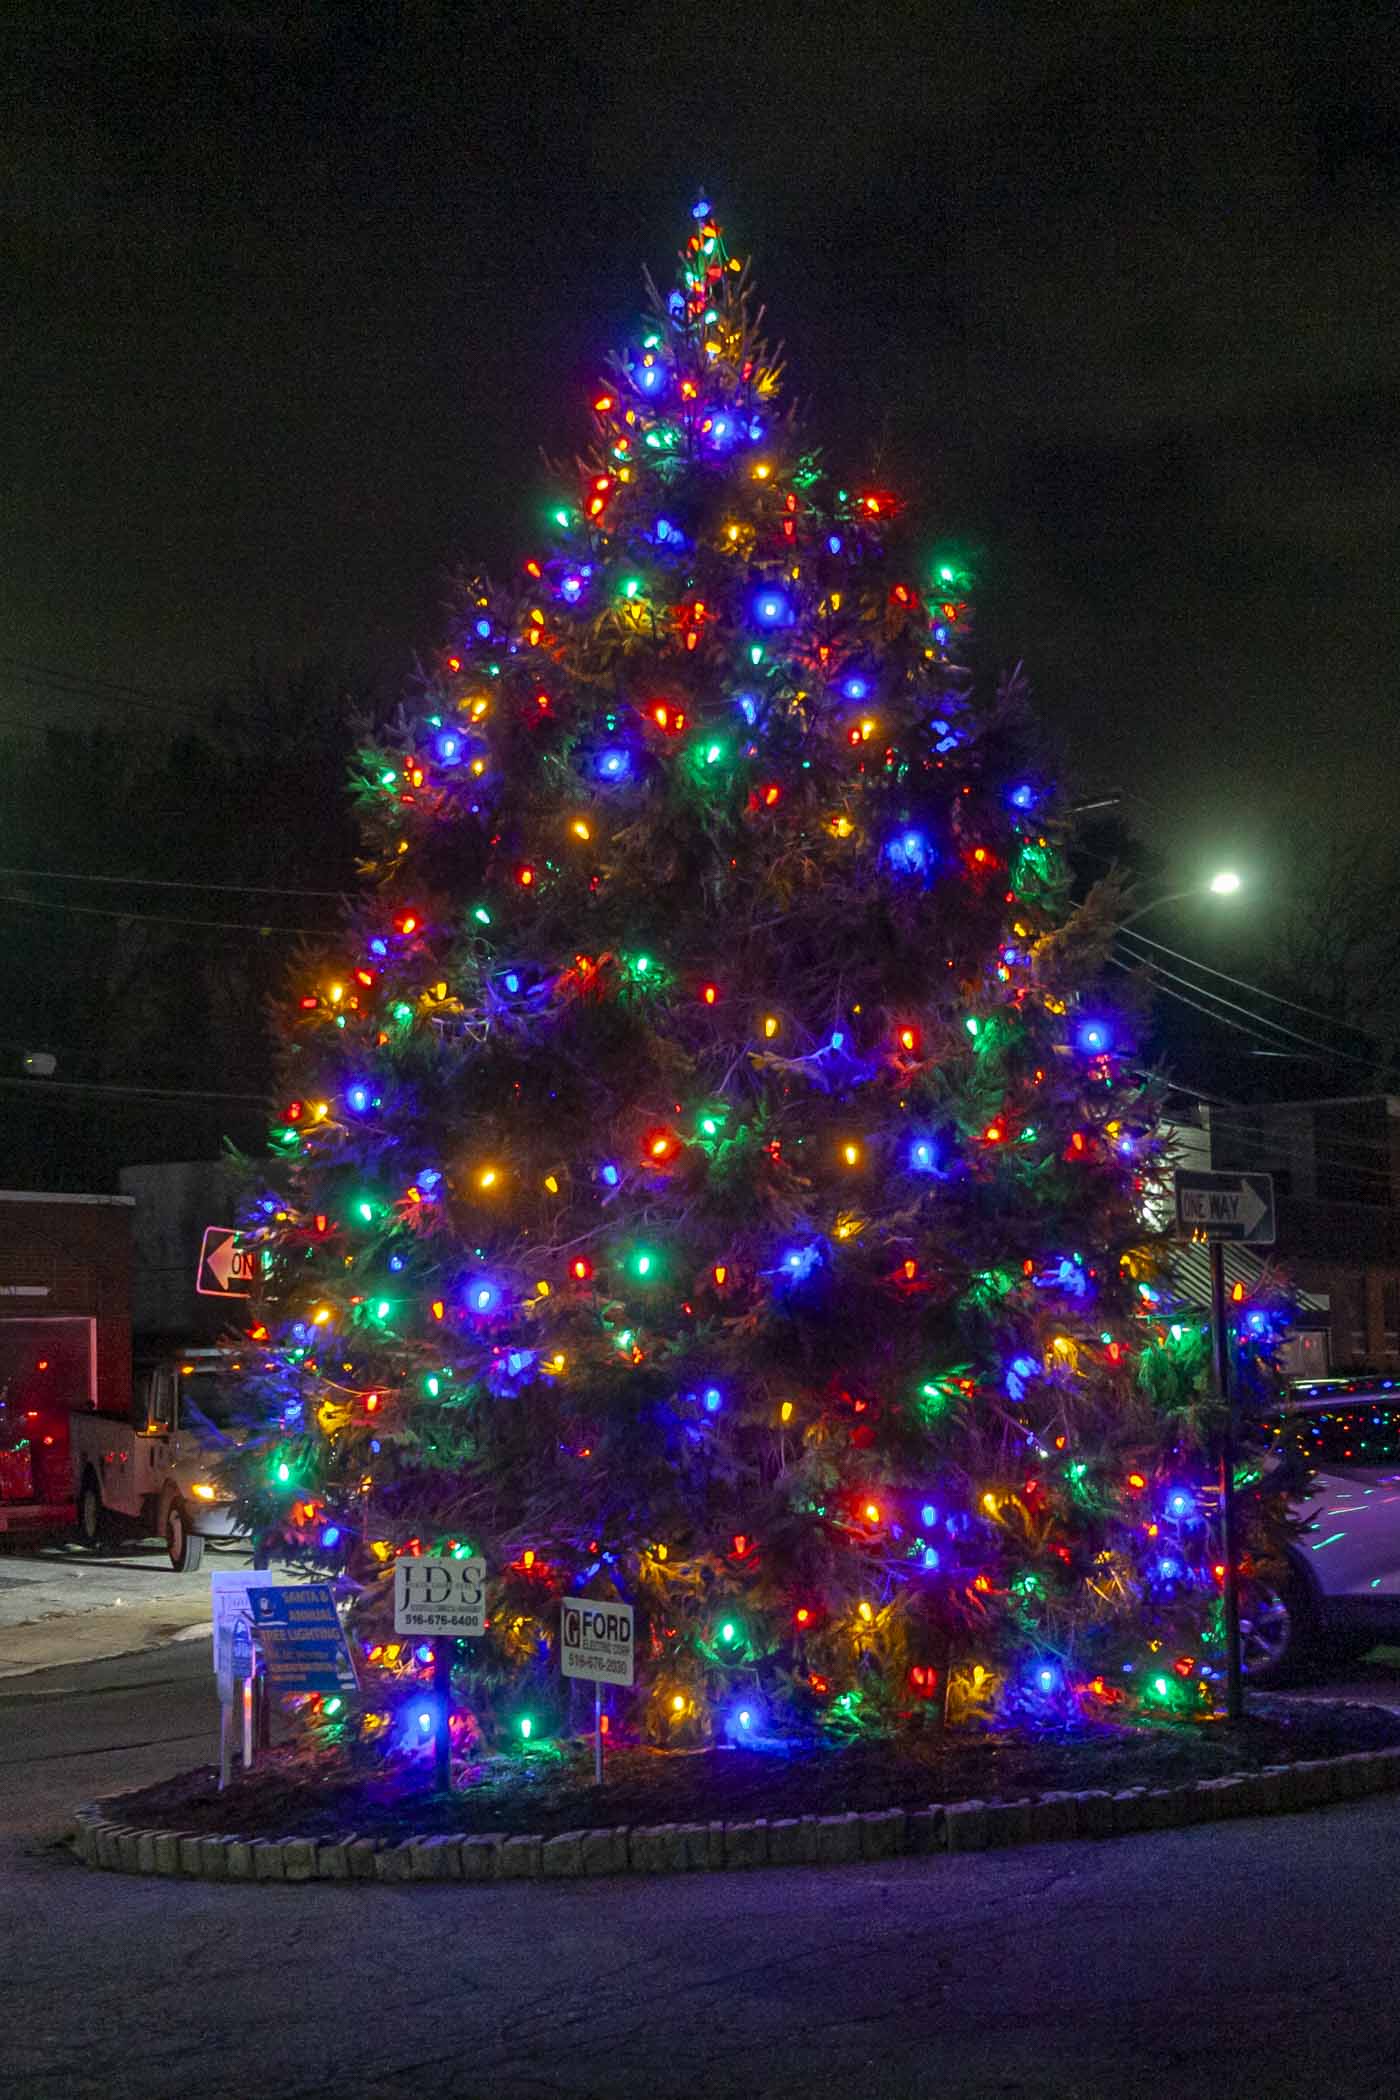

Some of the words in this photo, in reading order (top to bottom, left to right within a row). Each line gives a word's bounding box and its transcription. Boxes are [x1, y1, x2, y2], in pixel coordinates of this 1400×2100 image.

[1183, 1191, 1206, 1218] ONE
[1209, 1193, 1240, 1220] WAY
[231, 1252, 256, 1276] ON
[399, 1565, 482, 1612] JDS
[582, 1610, 631, 1643] FORD
